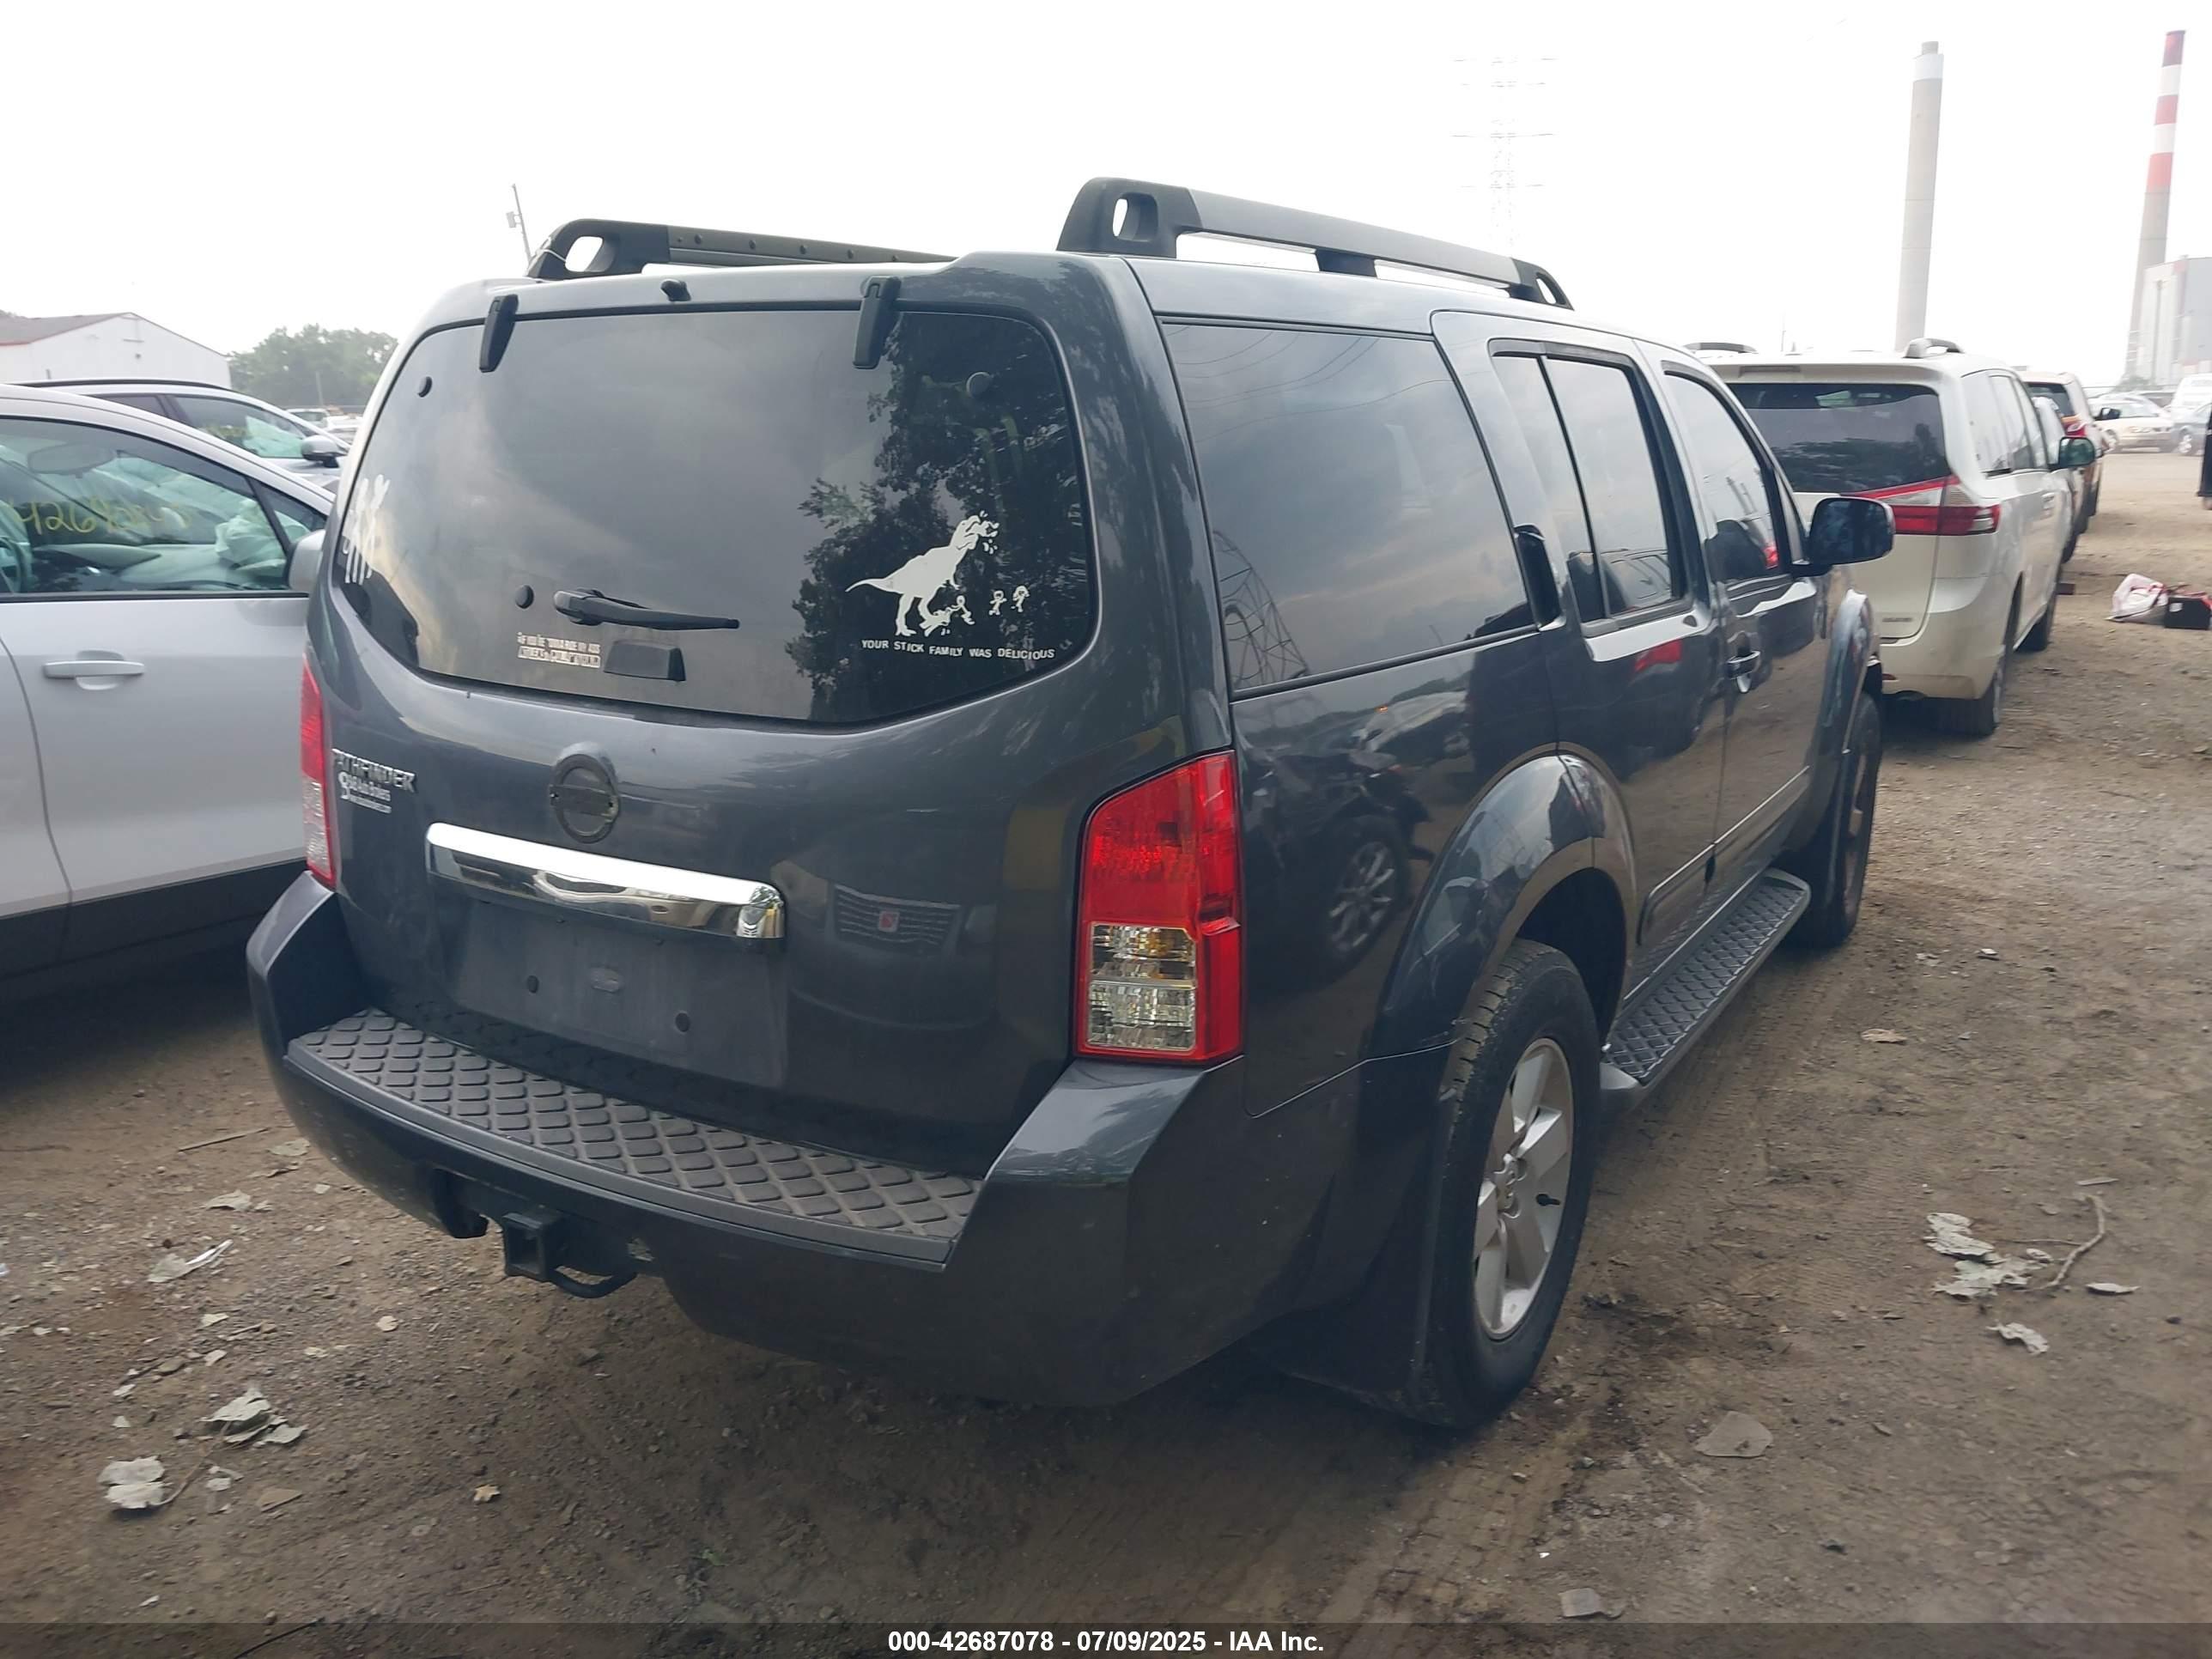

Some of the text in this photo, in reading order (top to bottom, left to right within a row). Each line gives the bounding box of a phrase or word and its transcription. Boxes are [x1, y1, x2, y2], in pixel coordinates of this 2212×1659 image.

[861, 640, 1055, 660] YOUR STICK FAMILY WAS DELICIOUS
